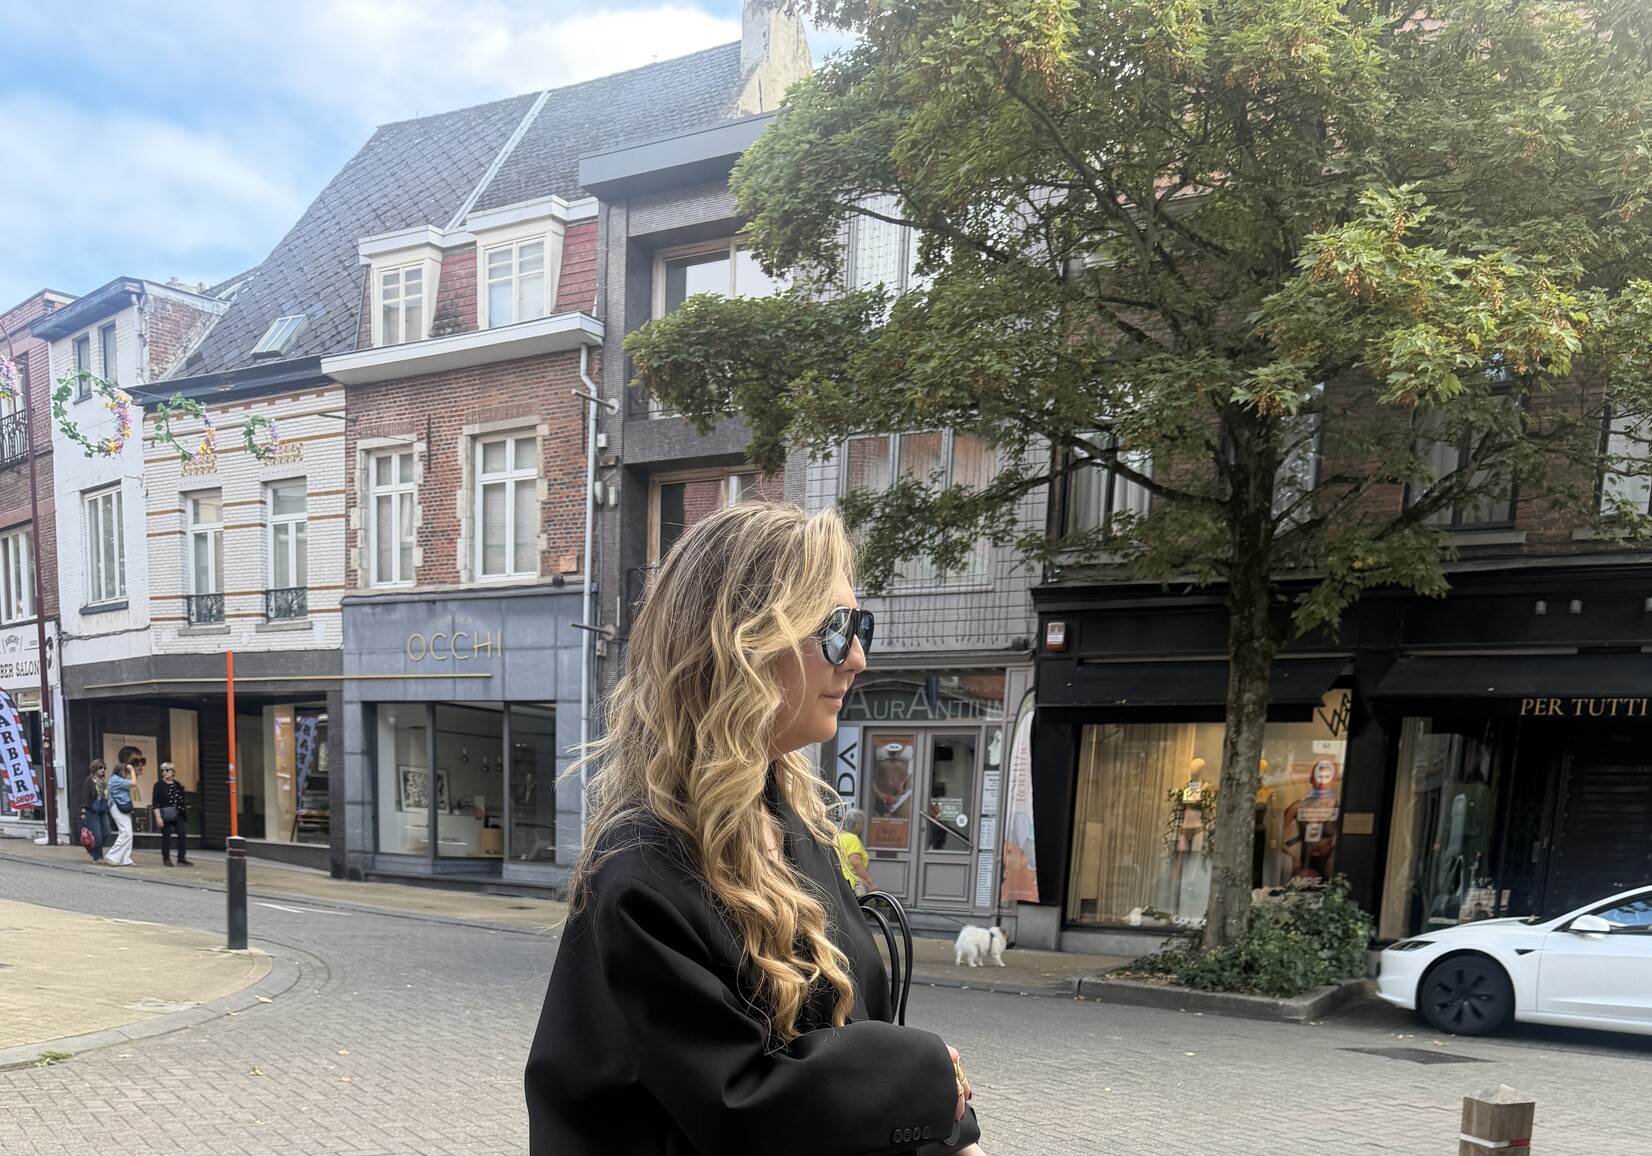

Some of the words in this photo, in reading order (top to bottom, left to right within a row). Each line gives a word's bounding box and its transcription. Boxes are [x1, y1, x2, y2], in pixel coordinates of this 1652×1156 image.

[406, 630, 502, 661] OCCHI
[15, 660, 40, 677] SALON
[1520, 698, 1564, 716] PER
[1571, 698, 1649, 717] TUTTI
[15, 793, 36, 804] SHOP
